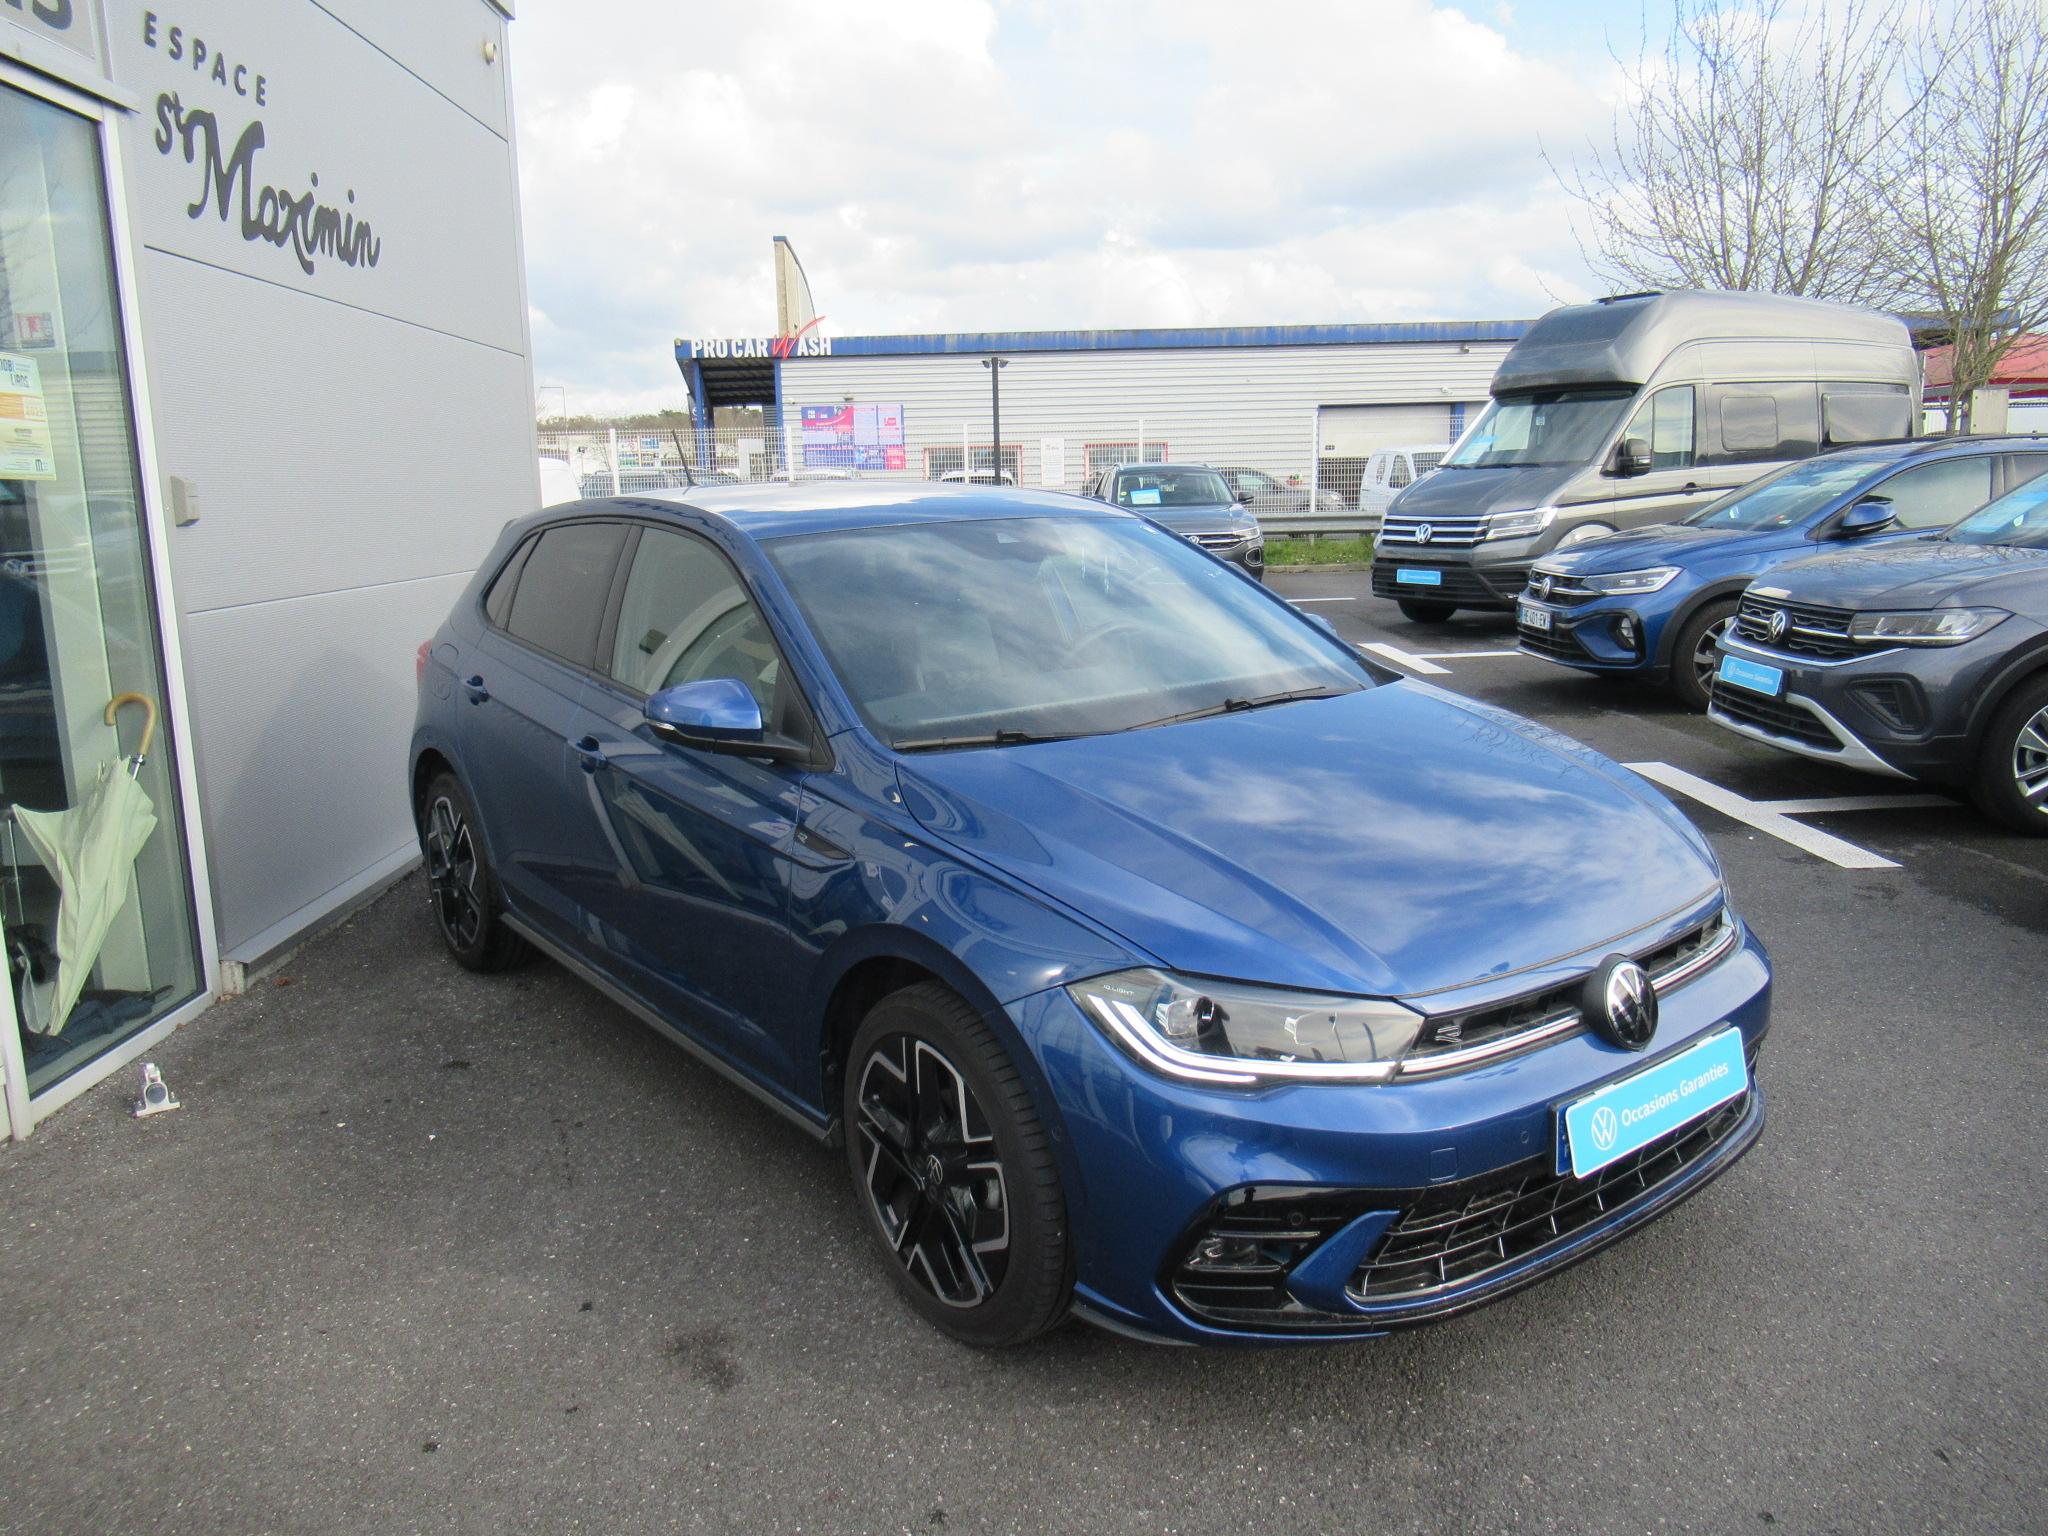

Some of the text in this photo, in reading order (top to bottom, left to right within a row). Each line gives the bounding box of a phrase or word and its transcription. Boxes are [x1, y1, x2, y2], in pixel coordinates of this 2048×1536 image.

[143, 10, 267, 108] ESPACE
[182, 108, 381, 276] Maximin
[690, 315, 832, 360] PRO CAR WASH
[1620, 1089, 1679, 1127] Occasions
[1679, 1061, 1729, 1098] Garanties
